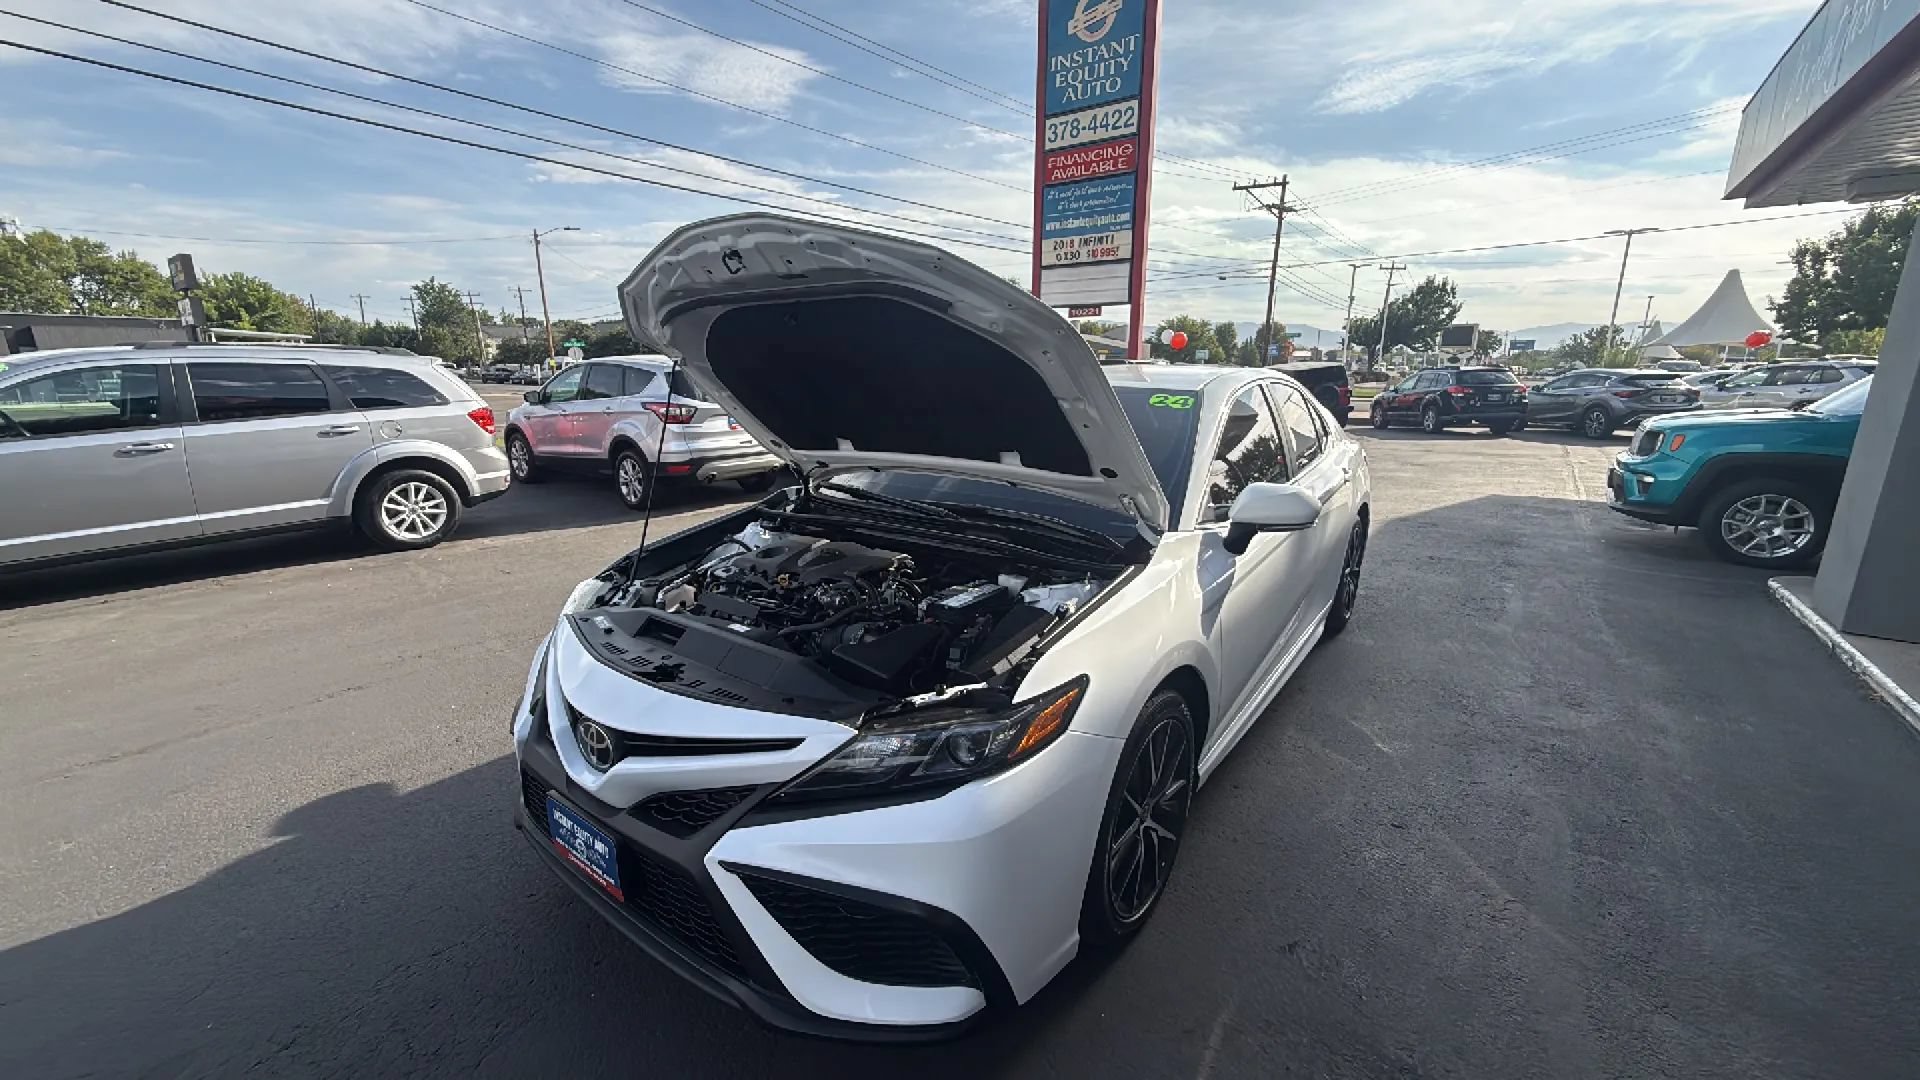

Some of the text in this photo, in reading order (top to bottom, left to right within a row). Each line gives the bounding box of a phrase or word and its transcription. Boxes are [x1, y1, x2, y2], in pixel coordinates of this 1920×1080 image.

[1050, 33, 1140, 72] INSTANT
[1055, 54, 1132, 88] EQUITY
[1062, 77, 1121, 103] AUTO
[1047, 106, 1135, 143] 378-4422
[1048, 143, 1133, 169] FINANCING
[1051, 157, 1128, 181] AVAILABLE
[1053, 239, 1075, 251] 2018
[1071, 308, 1100, 317] 10221
[1149, 394, 1194, 408] 24
